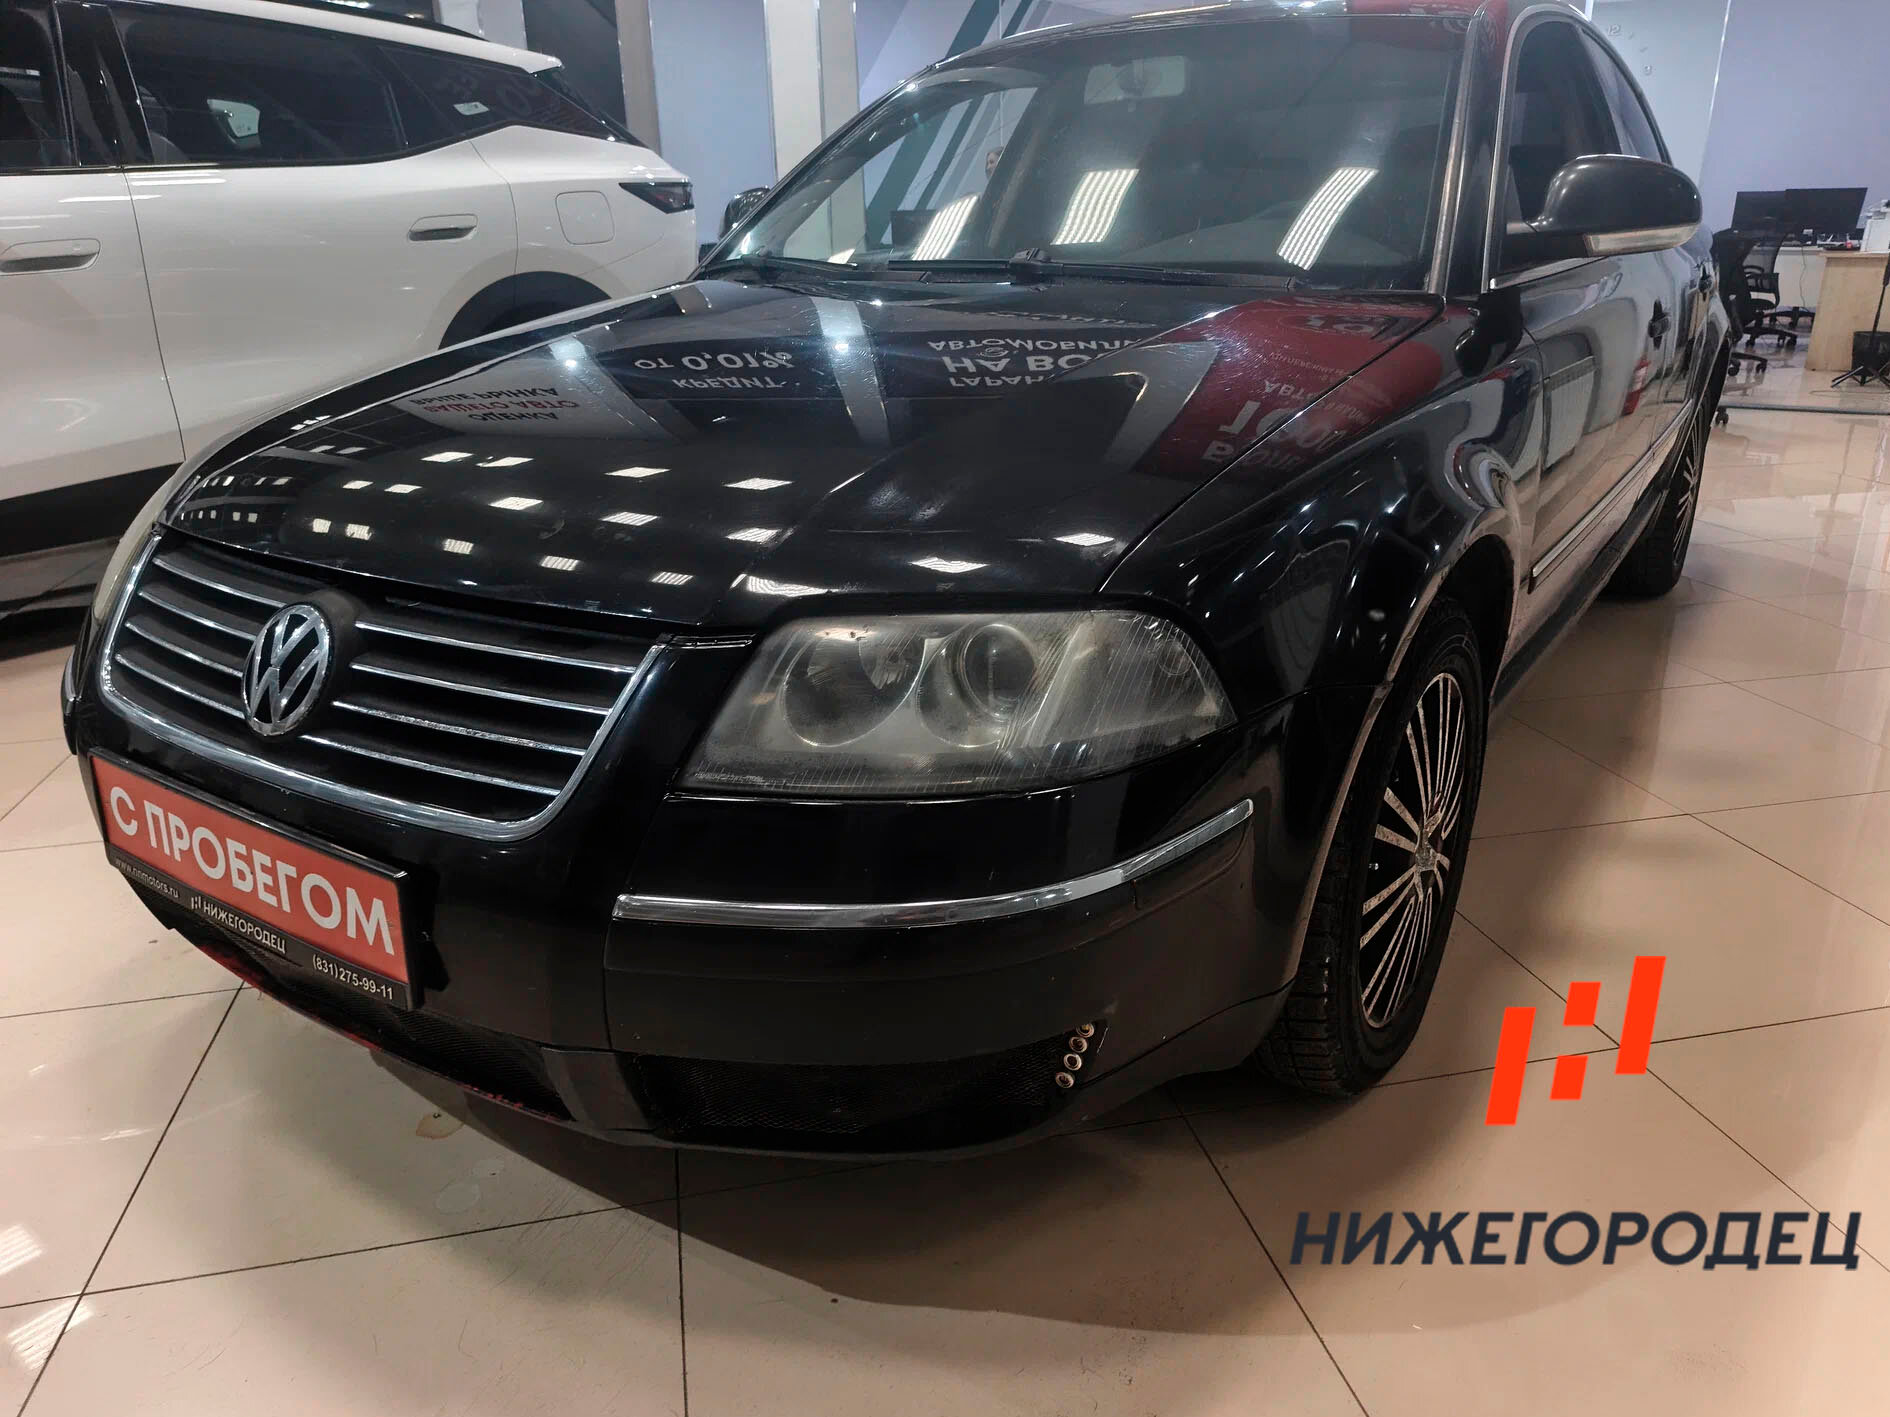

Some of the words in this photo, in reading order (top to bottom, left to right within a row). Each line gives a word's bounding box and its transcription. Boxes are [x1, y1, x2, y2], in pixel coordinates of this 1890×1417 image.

[110, 786, 138, 837] С
[144, 800, 395, 956] ПРОБЕГОМ
[203, 900, 286, 955] НИЖЕГОРОДЕЦ
[312, 954, 394, 1000] (831)275-99-11
